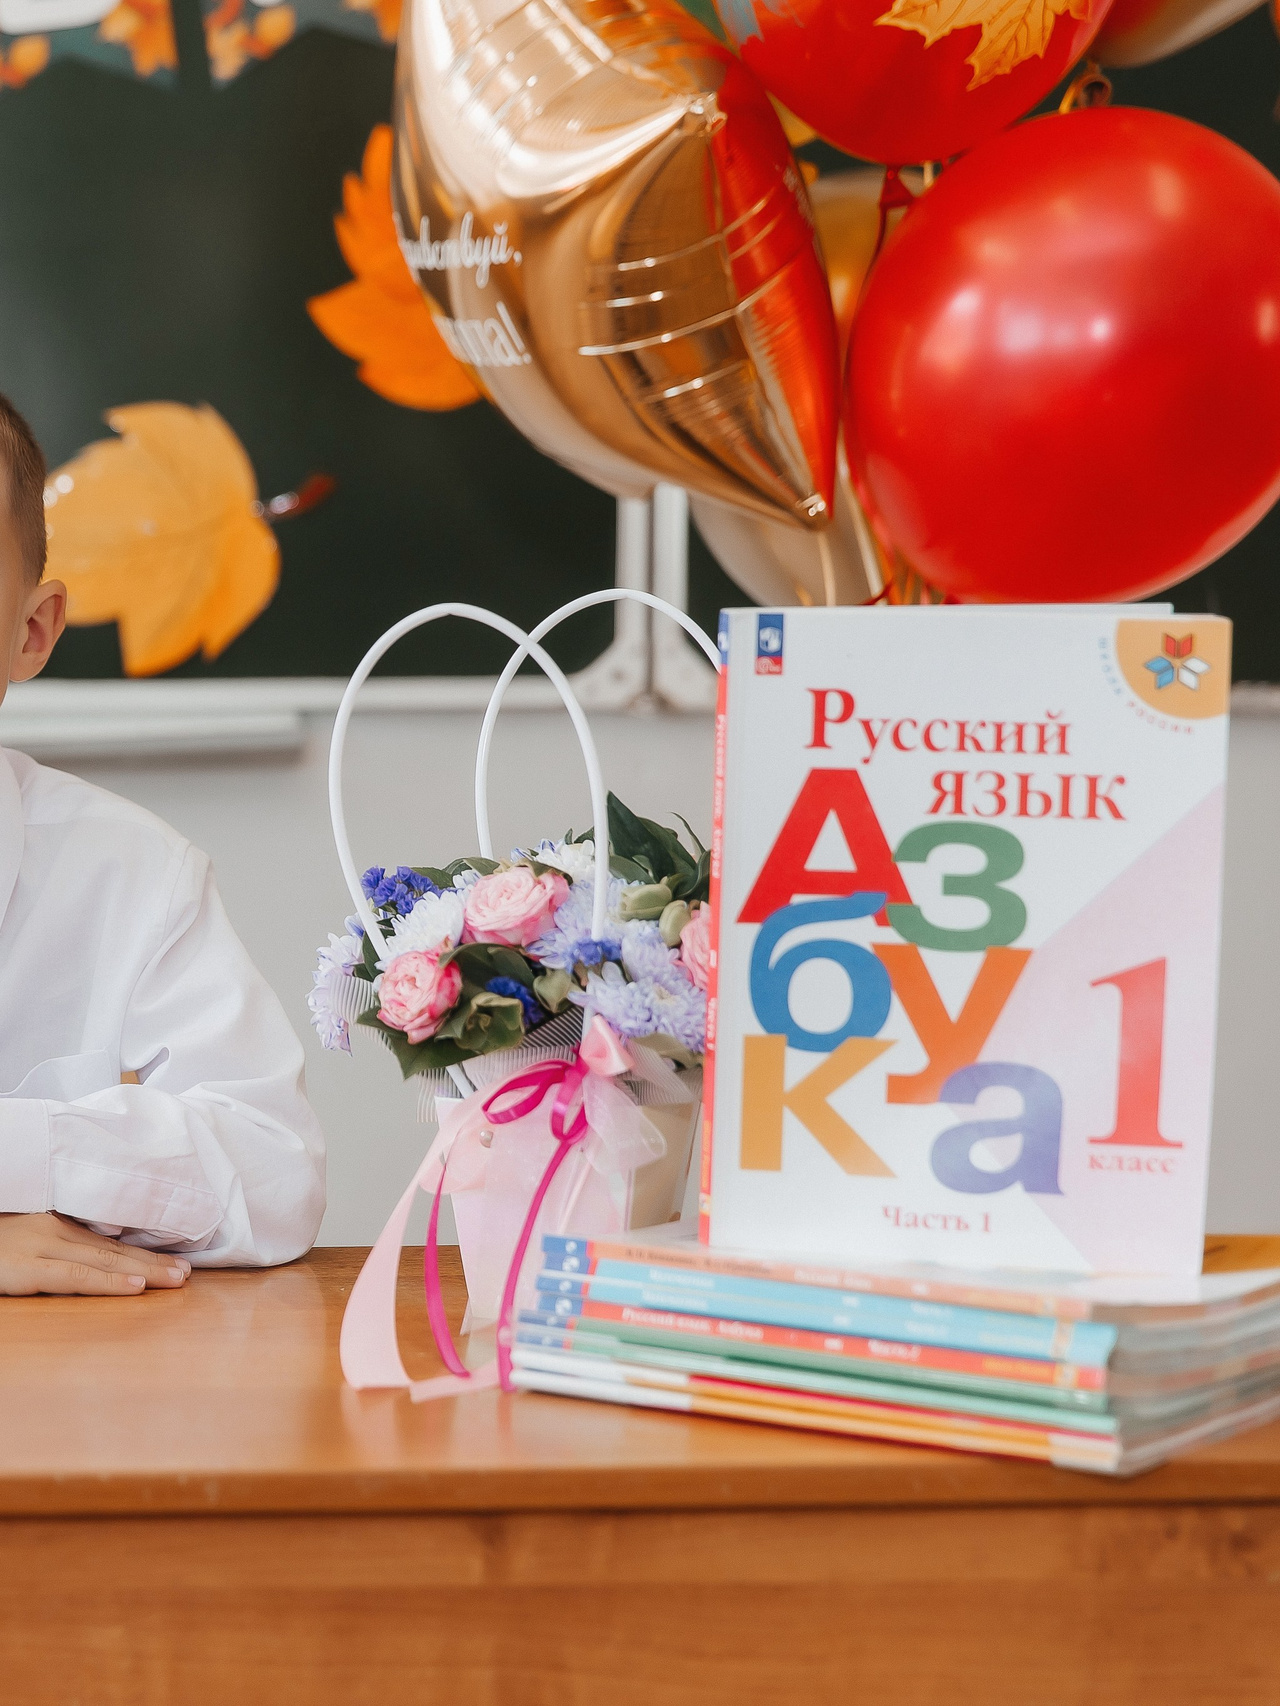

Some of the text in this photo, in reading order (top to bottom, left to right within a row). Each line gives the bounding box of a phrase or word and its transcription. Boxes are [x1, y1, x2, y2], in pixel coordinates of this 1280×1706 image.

[804, 688, 1070, 764] Русский
[1087, 956, 1184, 1149] 1
[1088, 1152, 1179, 1175] класс
[882, 1205, 993, 1233] Часть 1
